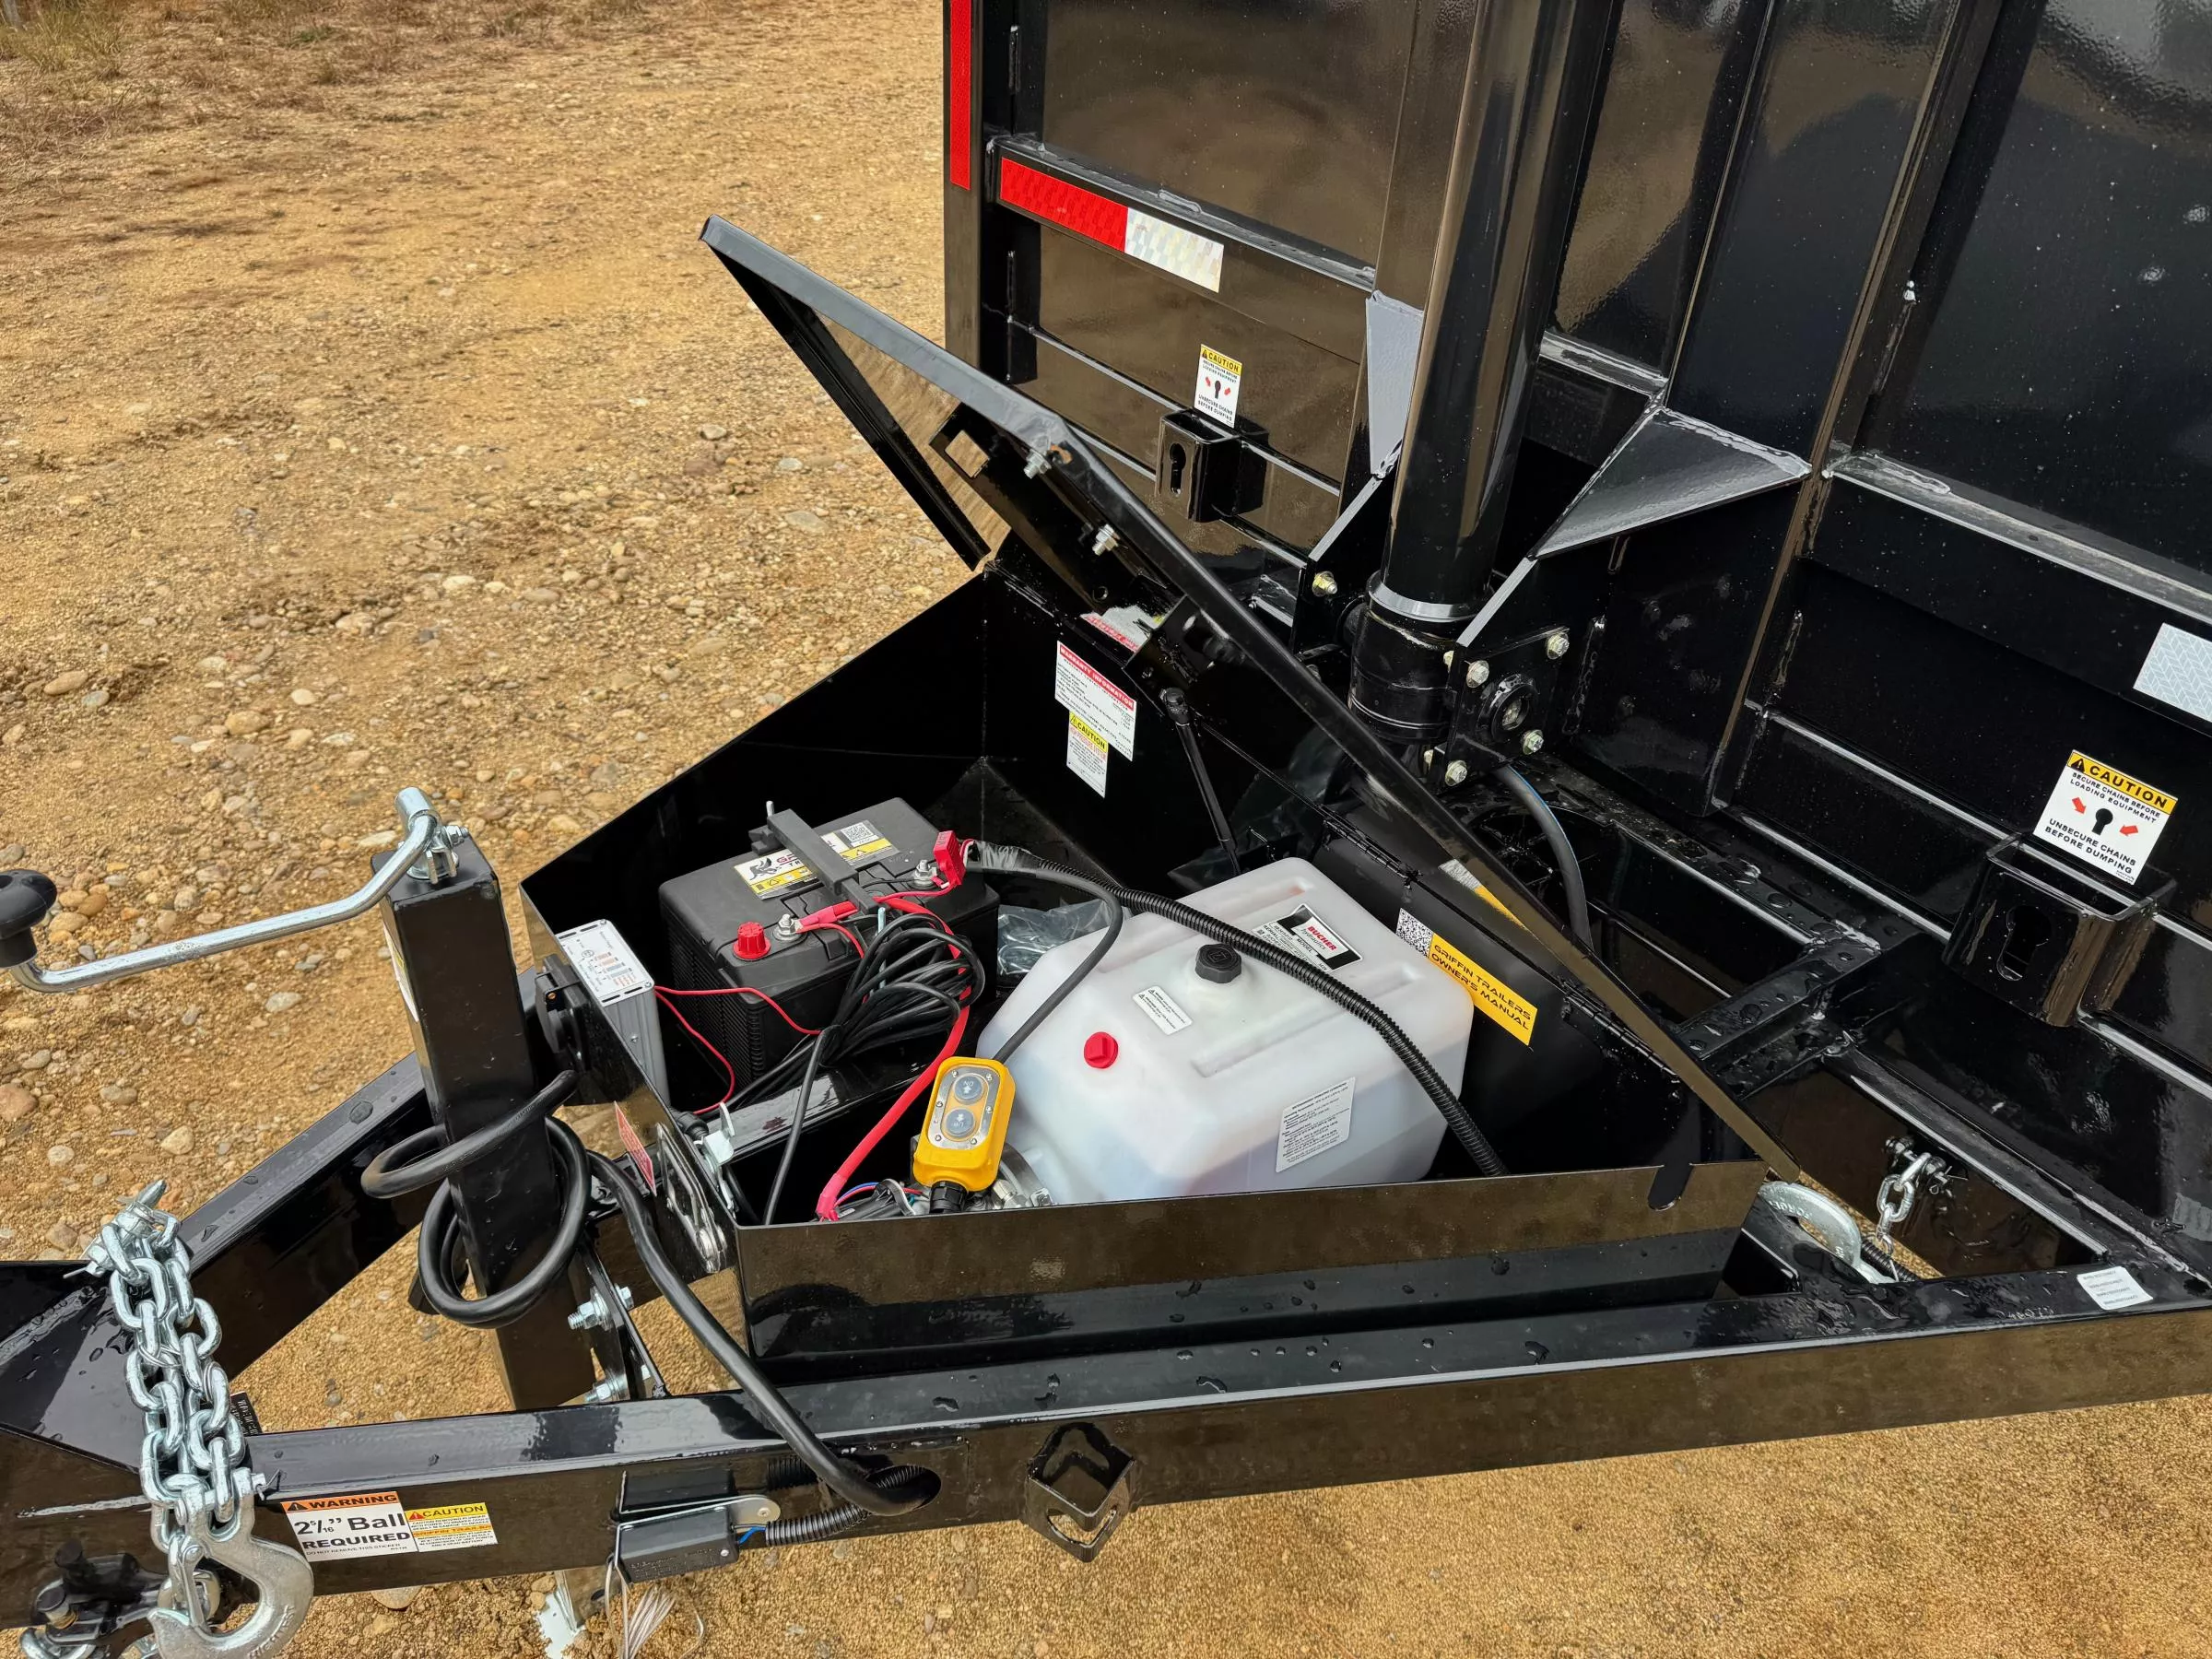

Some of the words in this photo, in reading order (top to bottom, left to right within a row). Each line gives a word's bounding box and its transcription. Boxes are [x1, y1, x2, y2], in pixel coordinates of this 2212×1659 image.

[1208, 352, 1239, 372] CAUTION
[1061, 647, 1091, 676] WARRANTY
[1092, 673, 1134, 706] INFORMATION
[1077, 722, 1105, 749] CAUTION
[2070, 779, 2105, 799] LOADING
[2108, 797, 2157, 823] EQUIPMENT
[2072, 772, 2100, 789] SECURE
[2101, 786, 2130, 803] CHAINS
[2131, 800, 2161, 818] BEFORE
[2089, 765, 2168, 808] CAUTION
[2044, 826, 2083, 849] BEFORE
[2086, 847, 2133, 874] DUMPING
[2049, 818, 2099, 847] UNSECURE
[2100, 844, 2136, 866] CHAINS
[1307, 925, 1337, 950] BUCHER
[1431, 953, 1478, 992] OWNER'S
[1480, 991, 1529, 1030] MANUAL
[1434, 945, 1474, 976] GRIFFIN
[1475, 975, 1531, 1020] TRAILERS
[309, 1494, 397, 1509] WARNING
[347, 1512, 406, 1531] Ball
[422, 1505, 484, 1518] CAUTION
[302, 1532, 410, 1549] REQUIRED
